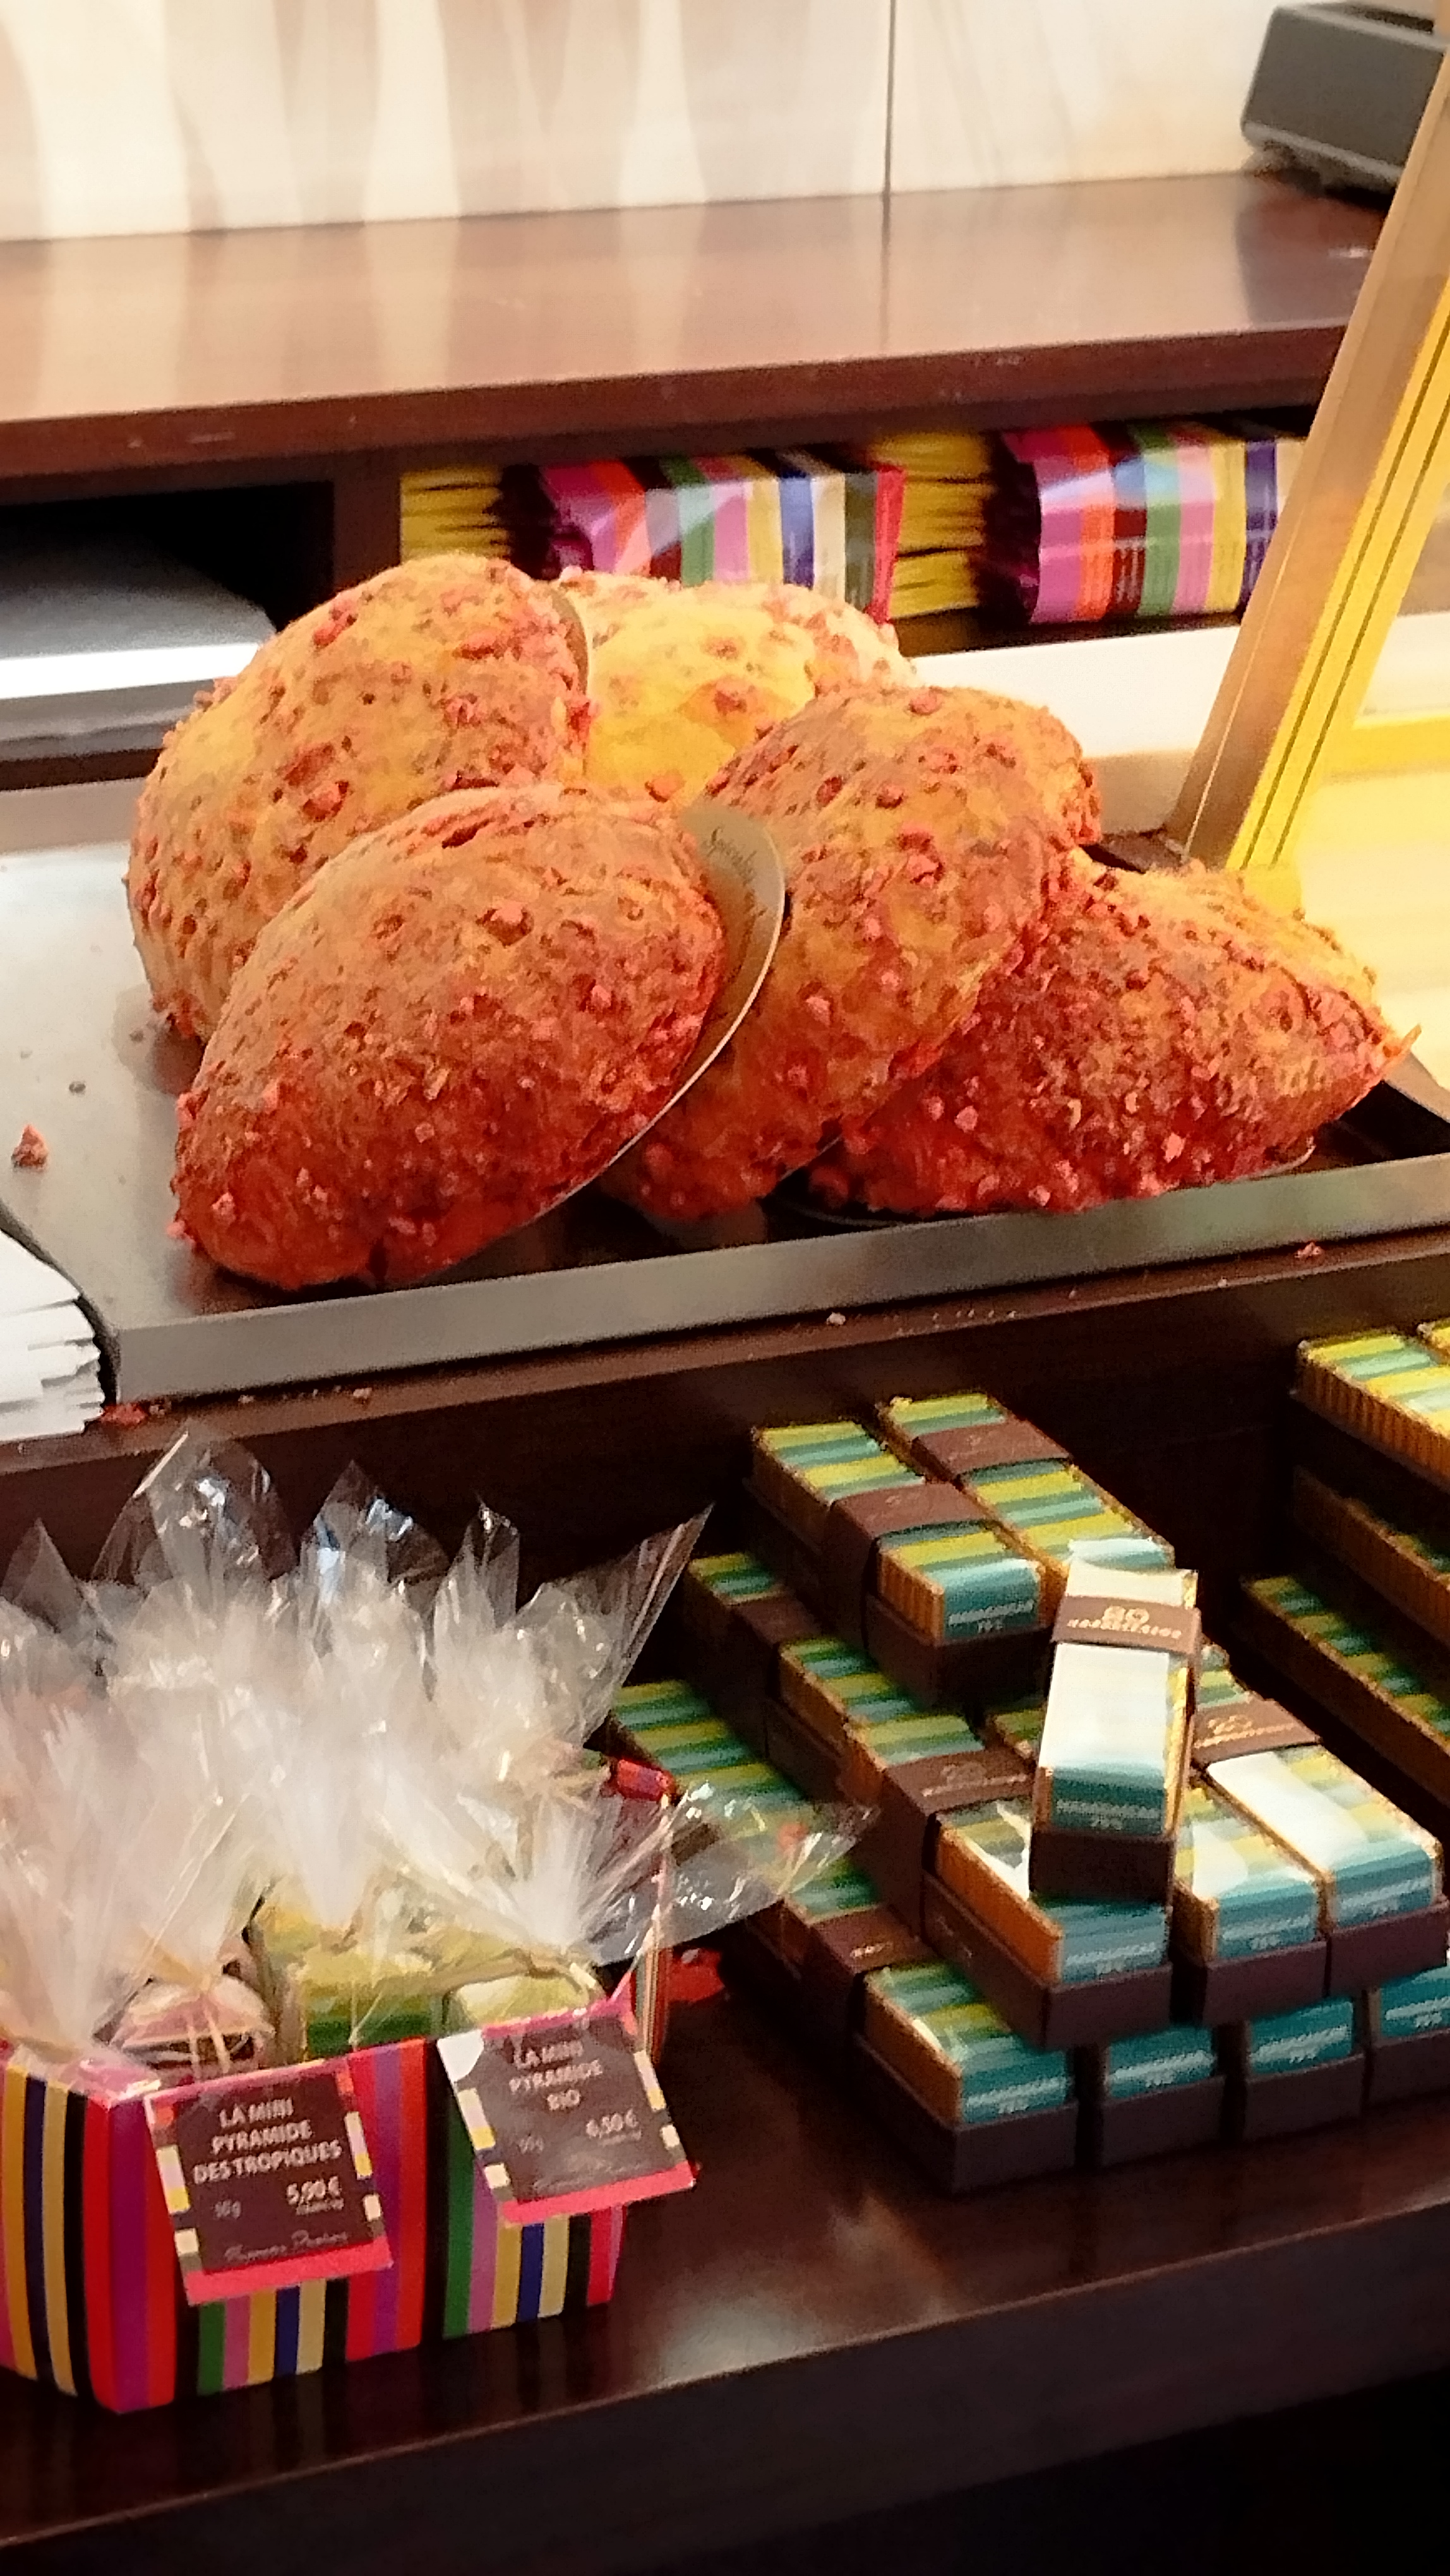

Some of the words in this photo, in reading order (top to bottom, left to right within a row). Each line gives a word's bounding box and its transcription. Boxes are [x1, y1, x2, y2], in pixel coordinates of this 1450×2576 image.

[220, 2103, 246, 2128] LA
[248, 2097, 294, 2123] MINI
[211, 2119, 315, 2155] PYRAMIDE
[193, 2159, 232, 2185] DES
